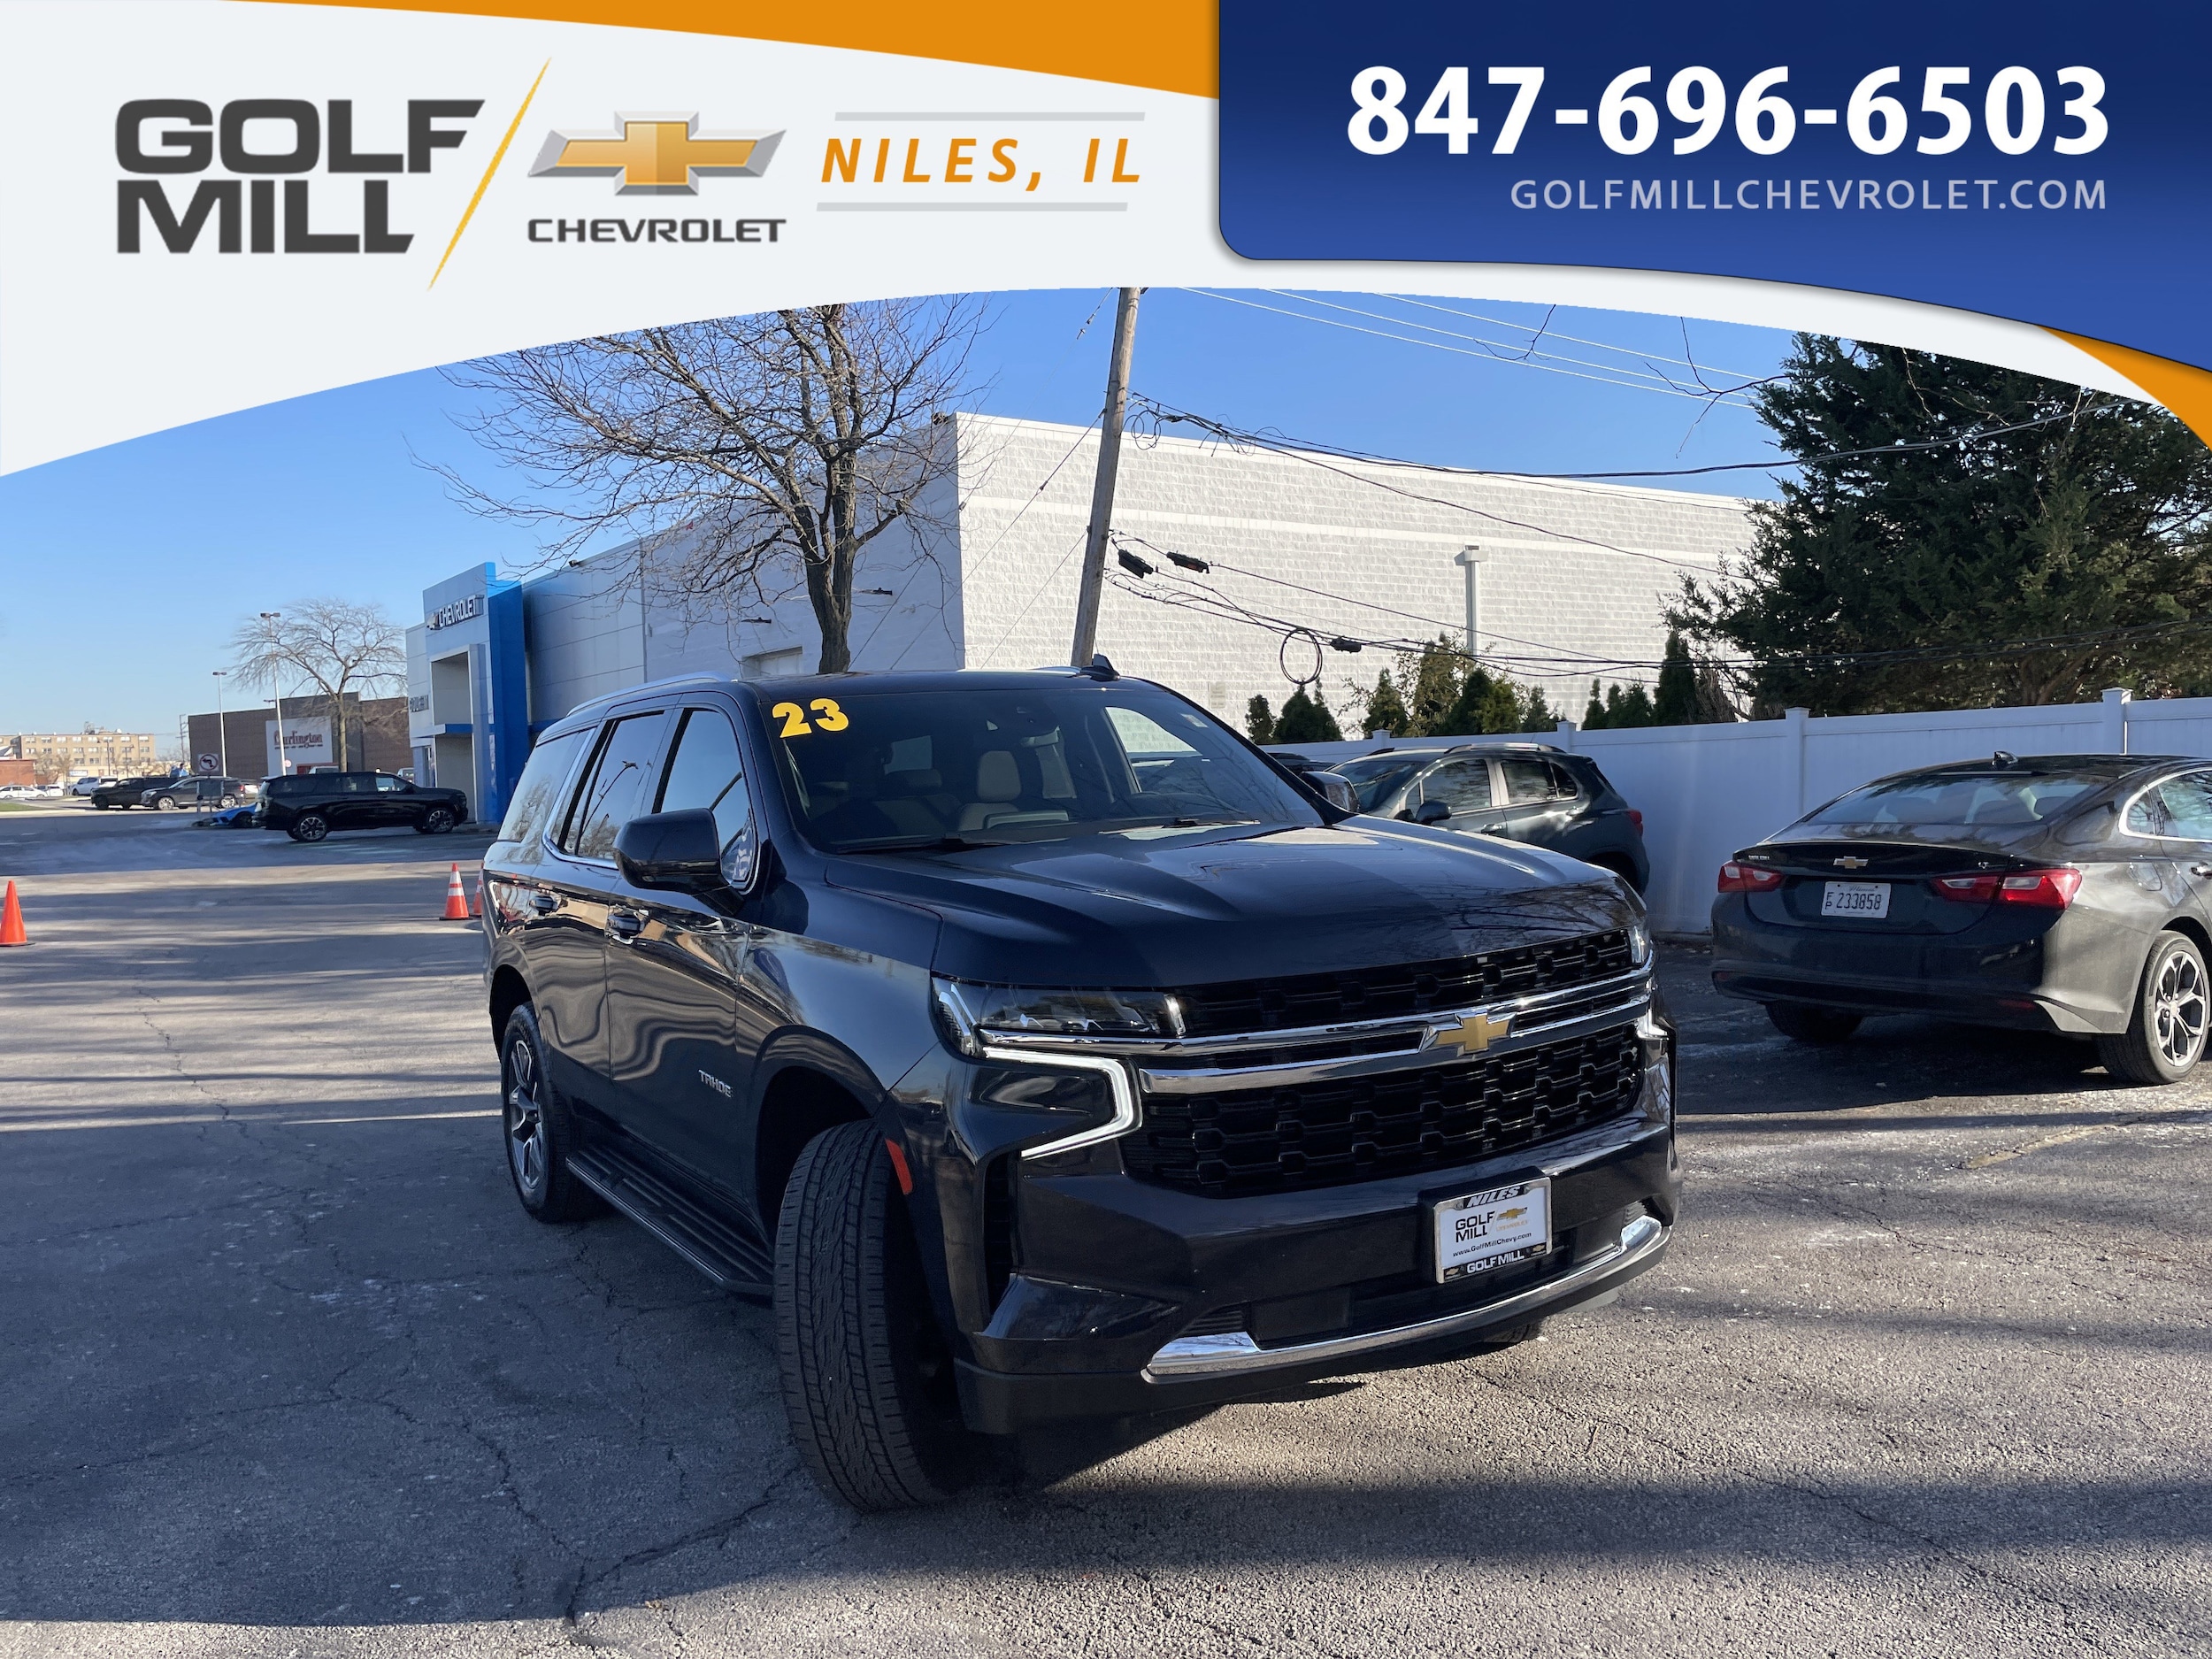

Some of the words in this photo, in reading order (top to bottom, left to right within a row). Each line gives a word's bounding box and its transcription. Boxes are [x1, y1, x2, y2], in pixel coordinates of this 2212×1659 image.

[438, 595, 477, 628] CHEVROLET
[772, 698, 849, 738] 23
[1836, 892, 1882, 910] 233858
[698, 1069, 733, 1098] TAHOE
[1466, 1185, 1521, 1208] NILES
[1455, 1210, 1495, 1231] GOLF
[1452, 1232, 1532, 1257] www.GolfMillChevy.com
[1455, 1225, 1488, 1243] MILL
[1466, 1256, 1497, 1274] GOLF
[1497, 1249, 1525, 1266] MILL
